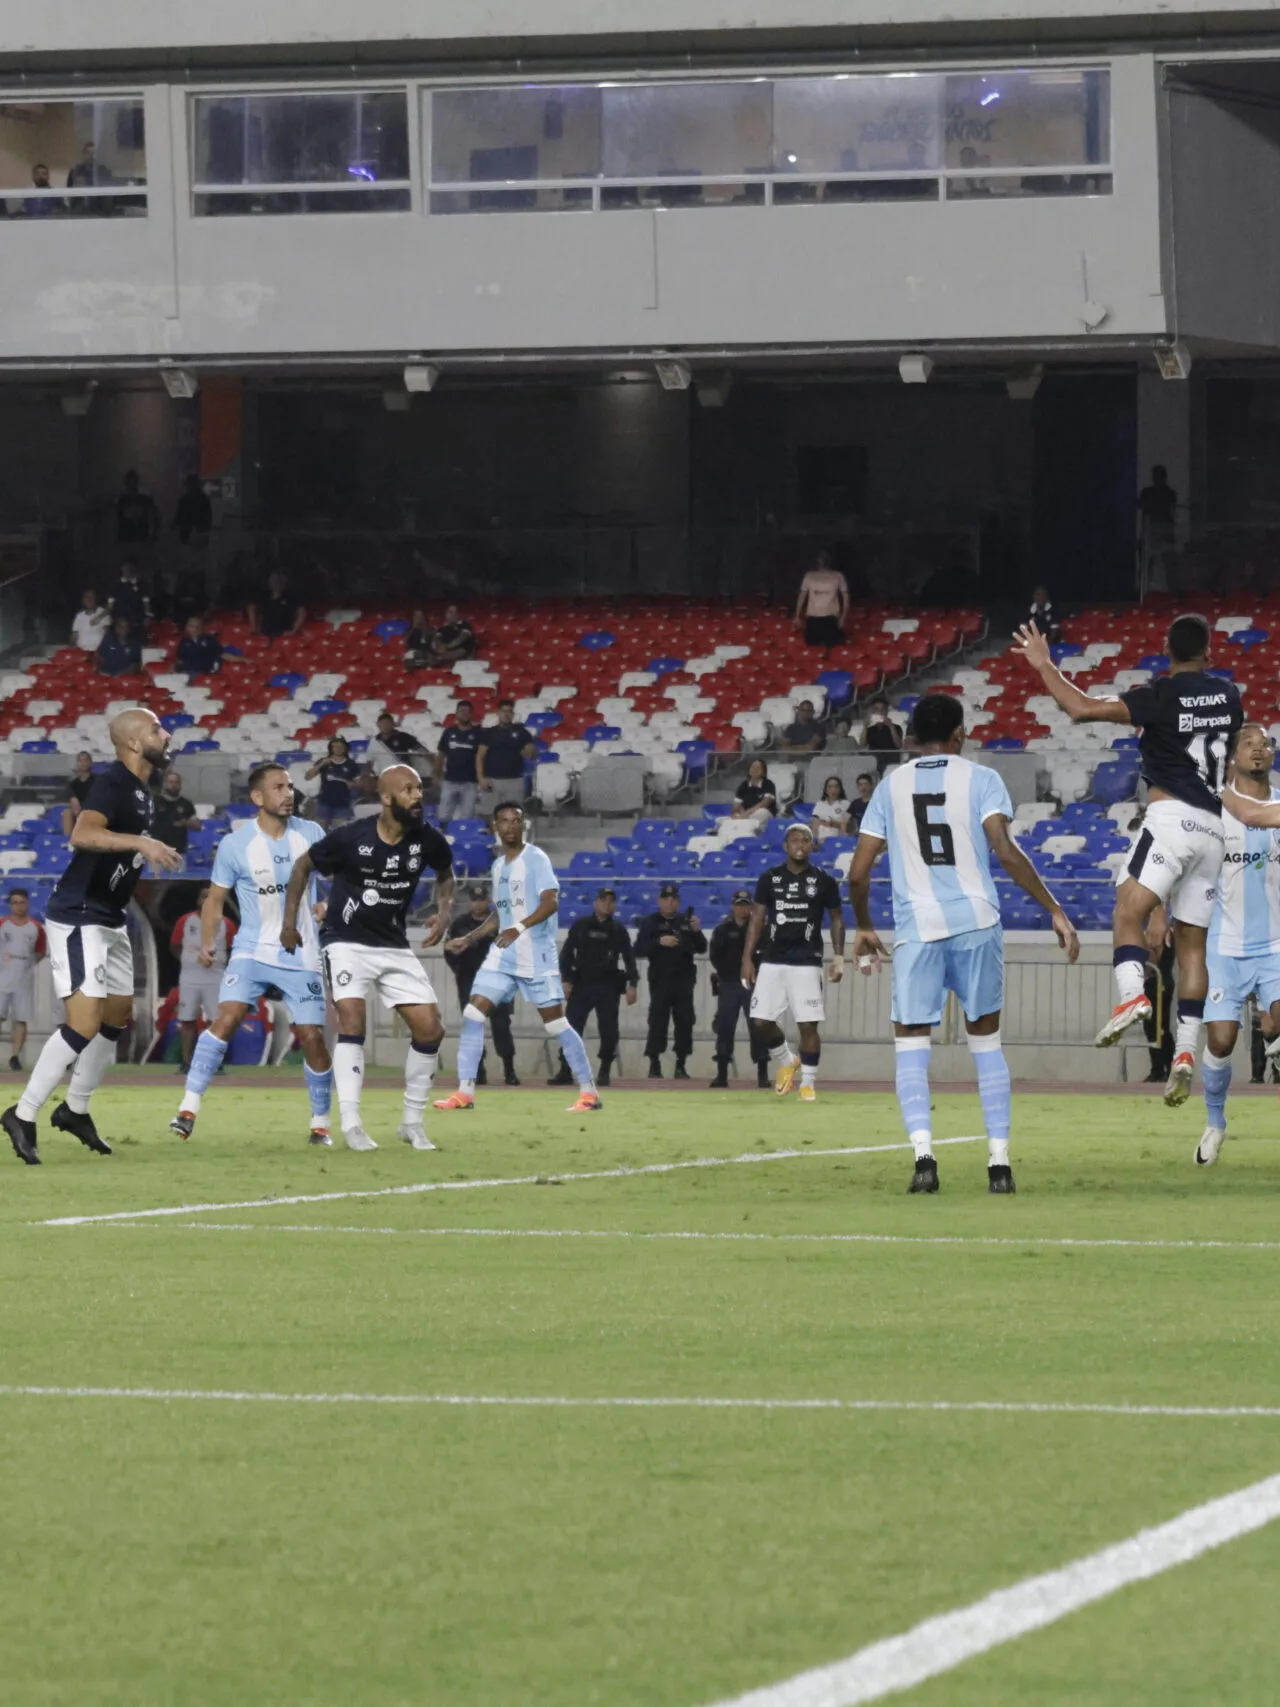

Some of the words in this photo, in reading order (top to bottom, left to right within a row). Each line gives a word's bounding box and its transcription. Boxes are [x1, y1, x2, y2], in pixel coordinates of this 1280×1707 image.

[1179, 694, 1227, 708] REVEMAR
[1193, 714, 1232, 728] Banpará
[1184, 732, 1229, 797] 11
[912, 792, 956, 866] 6
